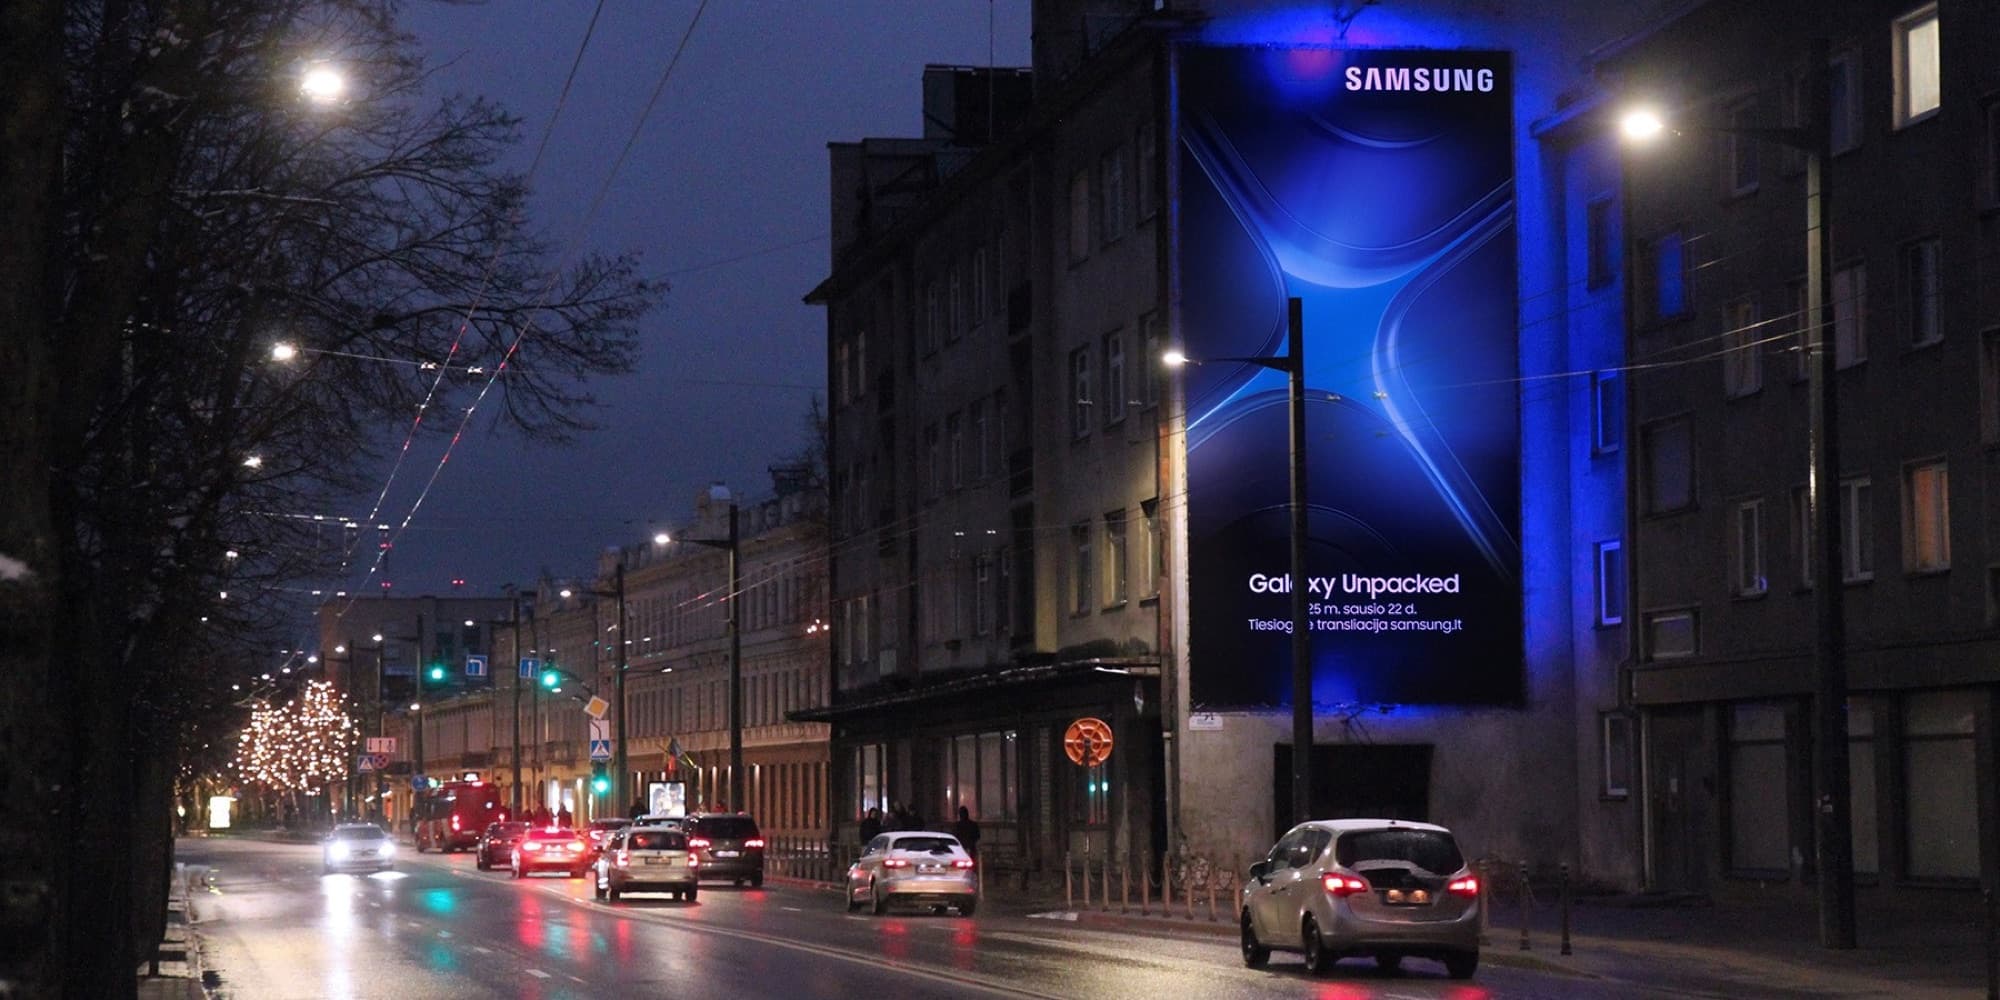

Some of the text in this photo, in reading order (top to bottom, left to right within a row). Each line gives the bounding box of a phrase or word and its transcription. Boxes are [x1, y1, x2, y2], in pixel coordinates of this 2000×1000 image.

[1345, 66, 1494, 92] SAMSUNG
[1248, 573, 1460, 600] Galxy Unpacked
[1324, 604, 1341, 615] m.
[1343, 602, 1386, 615] sausio
[1388, 602, 1402, 615] 22
[1405, 602, 1417, 615] d.
[1247, 618, 1463, 634] Tiesiog transliacija samsung.lt
